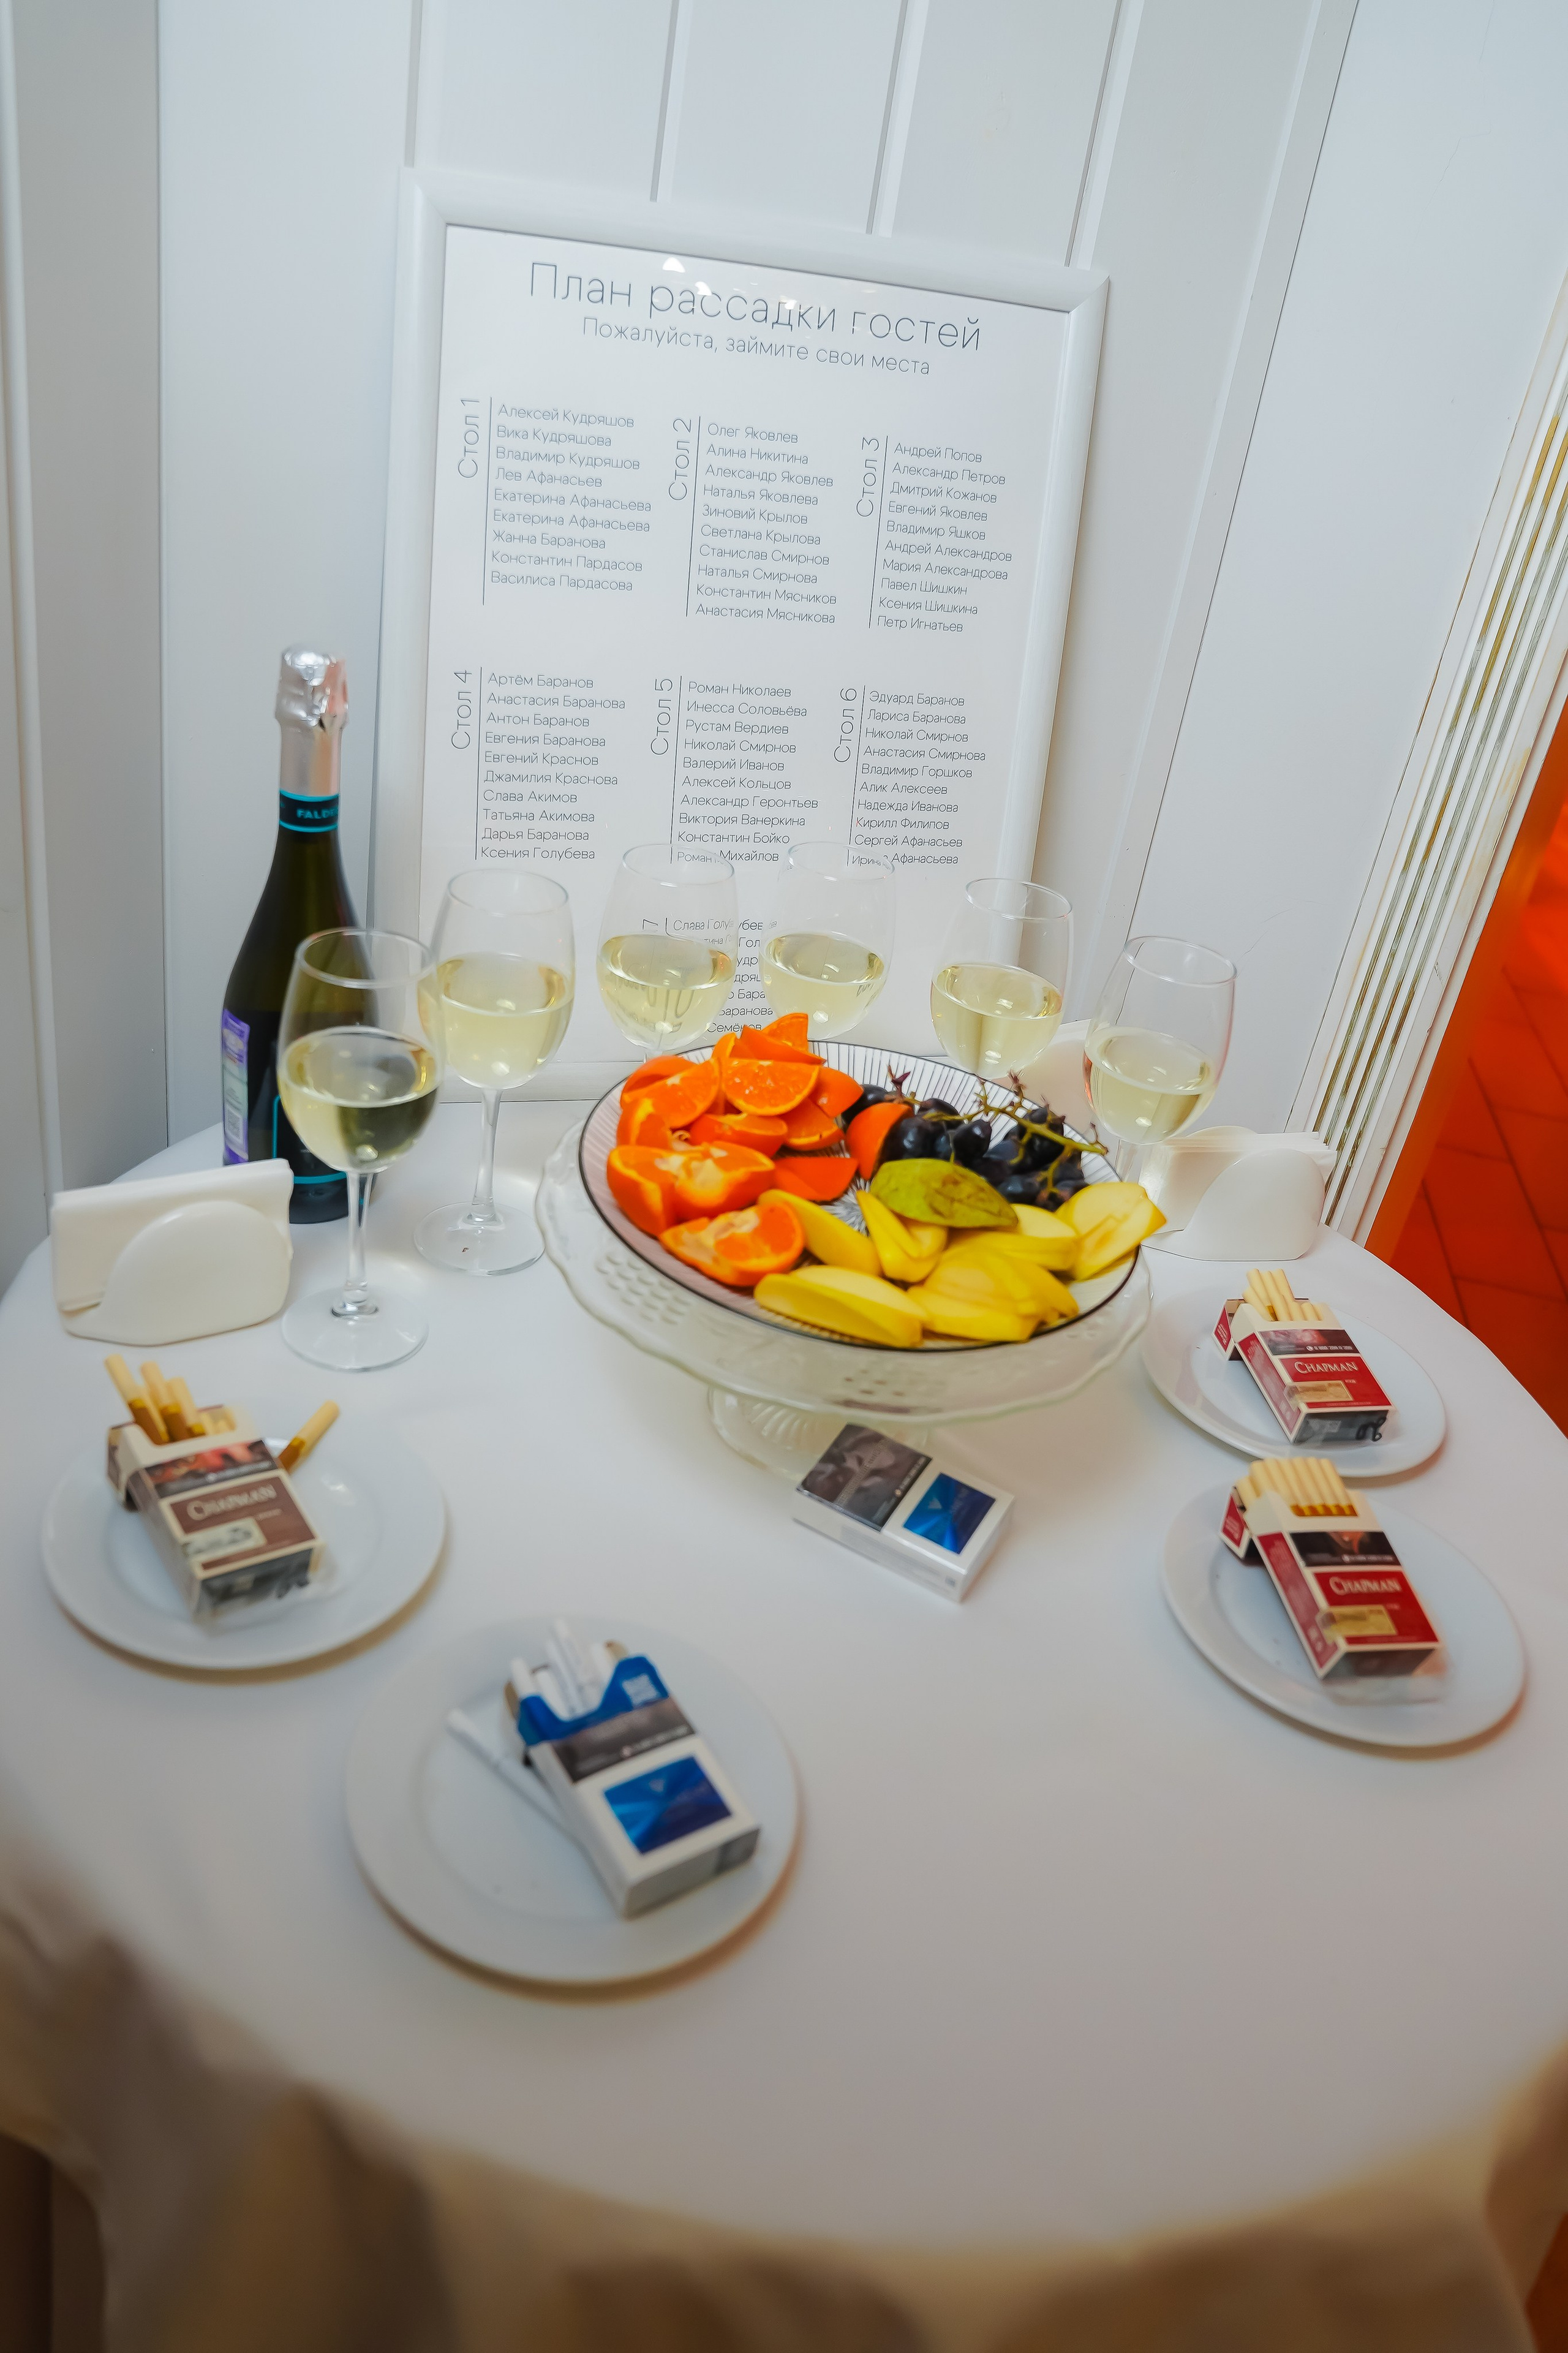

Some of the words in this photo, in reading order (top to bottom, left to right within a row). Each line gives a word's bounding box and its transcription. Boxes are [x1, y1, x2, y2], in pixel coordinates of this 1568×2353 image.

[530, 261, 631, 308] План
[649, 285, 836, 341] рассадки
[851, 311, 980, 351] гостей
[583, 317, 717, 353] Пожалуйста,
[725, 335, 809, 360] займите
[816, 349, 864, 367] свои
[872, 355, 929, 376] места
[497, 404, 559, 421] Алексей
[563, 409, 635, 428] Кудряшов
[673, 417, 692, 433] 2
[496, 423, 529, 440] Вика
[533, 428, 612, 447] Кудряшова
[707, 423, 741, 438] Олег
[745, 426, 798, 444] Яковлев
[458, 415, 480, 478] Стол
[861, 437, 880, 451] 3
[894, 442, 941, 459] Андрей
[944, 447, 982, 463] Попов
[496, 446, 565, 467] Владимир
[569, 452, 640, 470] Кудряшов
[706, 444, 747, 459] Алина
[750, 447, 809, 465] Никитина
[495, 467, 522, 482] Лев
[526, 470, 603, 488] Афанасьев
[668, 440, 690, 501] Стол
[704, 464, 777, 485] Александр
[780, 470, 834, 487] Яковлев
[892, 462, 960, 482] Александр
[961, 469, 1006, 486] Петров
[703, 483, 755, 500] Наталья
[758, 488, 818, 506] Яковлева
[856, 458, 878, 518] Стол
[889, 482, 944, 499] Дмитрий
[946, 486, 997, 504] Кожанов
[494, 488, 565, 507] Екатерина
[569, 494, 652, 512] Афанасьева
[702, 504, 756, 520] Зиновий
[759, 508, 808, 524] Крылов
[888, 500, 937, 516] Евгений
[940, 506, 988, 521] Яковлев
[493, 508, 564, 527] Екатерина
[568, 514, 650, 532] Афанасьева
[701, 524, 763, 541] Светлана
[766, 529, 821, 545] Крылова
[886, 519, 946, 539] Владимир
[948, 526, 986, 541] Яшков
[492, 529, 537, 545] Жанна
[541, 532, 606, 550] Баранова
[699, 544, 768, 561] Станислав
[769, 548, 830, 567] Смирнов
[884, 539, 932, 556] Андрей
[933, 543, 1012, 563] Александров
[492, 550, 573, 567] Константин
[576, 556, 643, 572] Пардасов
[883, 558, 921, 574] Мария
[924, 562, 1008, 581] Александрова
[491, 570, 556, 587] Василиса
[559, 575, 633, 591] Пардасова
[698, 564, 749, 579] Наталья
[752, 568, 818, 584] Смирнова
[696, 583, 771, 600] Константин
[774, 589, 837, 605] Мясников
[881, 577, 917, 591] Павел
[919, 580, 968, 595] Шишкин
[695, 603, 764, 619] Анастасия
[766, 607, 835, 624] Мясникова
[879, 596, 922, 611] Ксения
[925, 600, 978, 615] Шишкина
[877, 615, 908, 631] Петр
[910, 618, 963, 632] Игнатьев
[454, 670, 472, 684] 4
[488, 672, 533, 688] Артём
[537, 674, 594, 690] Баранов
[654, 678, 673, 692] 5
[688, 681, 729, 694] Роман
[732, 683, 791, 698] Николаев
[840, 688, 857, 701] 6
[486, 692, 559, 707] Анастасия
[563, 695, 625, 711] Баранова
[869, 690, 914, 706] Эдуард
[916, 693, 965, 708] Баранов
[687, 700, 735, 714] Инесса
[738, 702, 807, 717] Соловьёва
[867, 709, 910, 723] Лариса
[912, 711, 966, 725] Баранова
[451, 691, 472, 750] Стол
[486, 711, 530, 725] Антон
[533, 713, 590, 729] Баранов
[650, 699, 671, 755] Стол
[685, 719, 731, 734] Рустам
[734, 721, 789, 736] Вердиев
[485, 731, 540, 745] Евгения
[543, 733, 606, 749] Баранова
[834, 709, 855, 763] Стол
[865, 727, 913, 741] Николай
[916, 729, 968, 744] Смирнов
[684, 738, 736, 751] Николай
[739, 739, 797, 755] Смирнов
[863, 745, 925, 758] Анастасия
[928, 747, 986, 762] Смирнова
[484, 750, 538, 764] Евгений
[542, 752, 599, 767] Краснов
[683, 757, 736, 772] Валерий
[739, 758, 785, 771] Иванов
[483, 770, 552, 784] Джамилия
[555, 772, 618, 787] Краснова
[860, 763, 919, 779] Владимир
[921, 765, 973, 779] Горшков
[681, 775, 736, 788] Алексей
[739, 777, 791, 791] Кольцов
[859, 781, 888, 793] Алик
[890, 782, 948, 795] Алексеев
[483, 789, 524, 802] Слава
[527, 790, 578, 804] Акимов
[680, 794, 750, 809] Александр
[752, 796, 818, 810] Геронтьев
[858, 798, 908, 812] Надежда
[911, 800, 959, 813] Иванова
[482, 808, 535, 821] Татьяна
[538, 809, 595, 823] Акимова
[679, 812, 738, 827] Виктория
[741, 814, 805, 828] Ванеркина
[854, 817, 897, 830] Кирилл
[900, 817, 949, 830] Филипов
[480, 827, 524, 842] Дарья
[527, 828, 589, 843] Баранова
[677, 831, 750, 843] Константин
[753, 831, 790, 844] Бойко
[854, 834, 899, 848] Сергей
[900, 835, 963, 848] Афанасьев
[481, 846, 531, 858] Ксения
[533, 847, 595, 862] Голубева
[677, 852, 712, 863] Роман
[720, 850, 779, 861] Михайлов
[891, 853, 959, 865] Афанасьева
[673, 920, 705, 931] Слава
[1294, 1361, 1359, 1374] CHAPMAN
